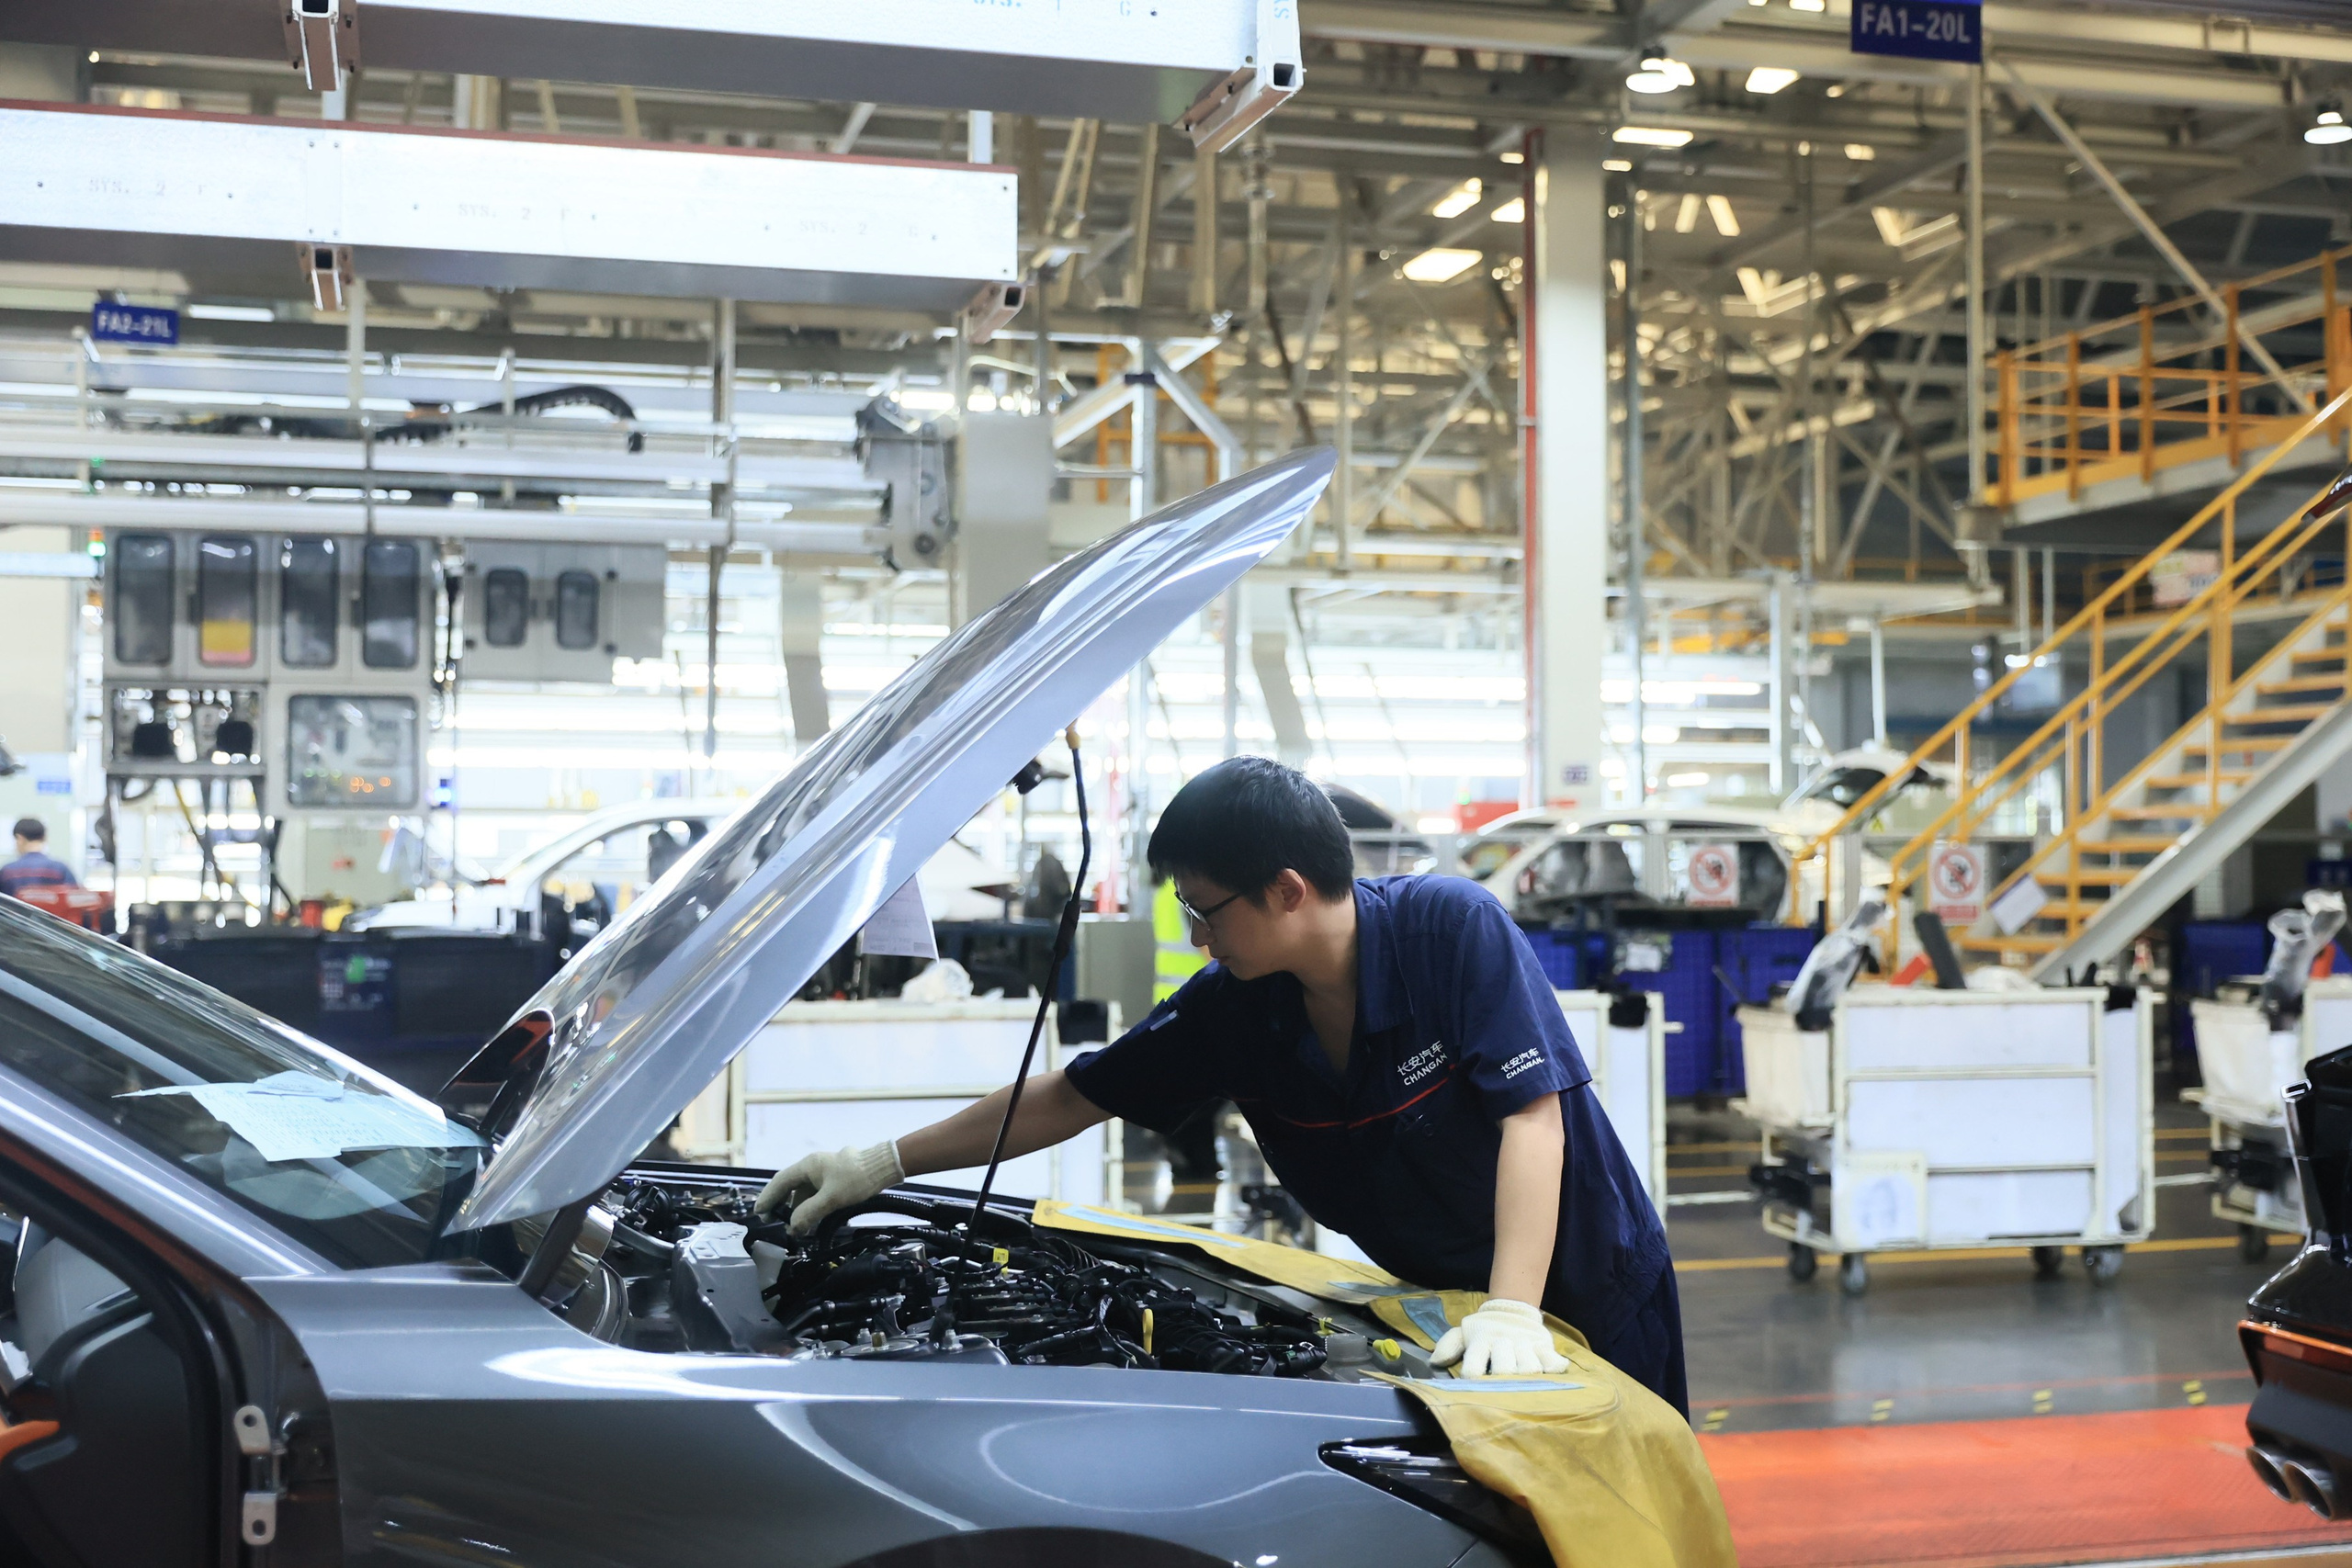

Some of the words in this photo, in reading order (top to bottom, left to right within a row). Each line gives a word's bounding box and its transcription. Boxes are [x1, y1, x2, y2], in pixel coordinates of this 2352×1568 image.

[1860, 2, 1972, 44] FA1-20L
[1396, 1040, 1443, 1076] 长安汽车
[1404, 1053, 1448, 1086] CHANGAN
[1500, 1047, 1540, 1072] 长安汽车
[1505, 1056, 1544, 1079] CHANGAN
